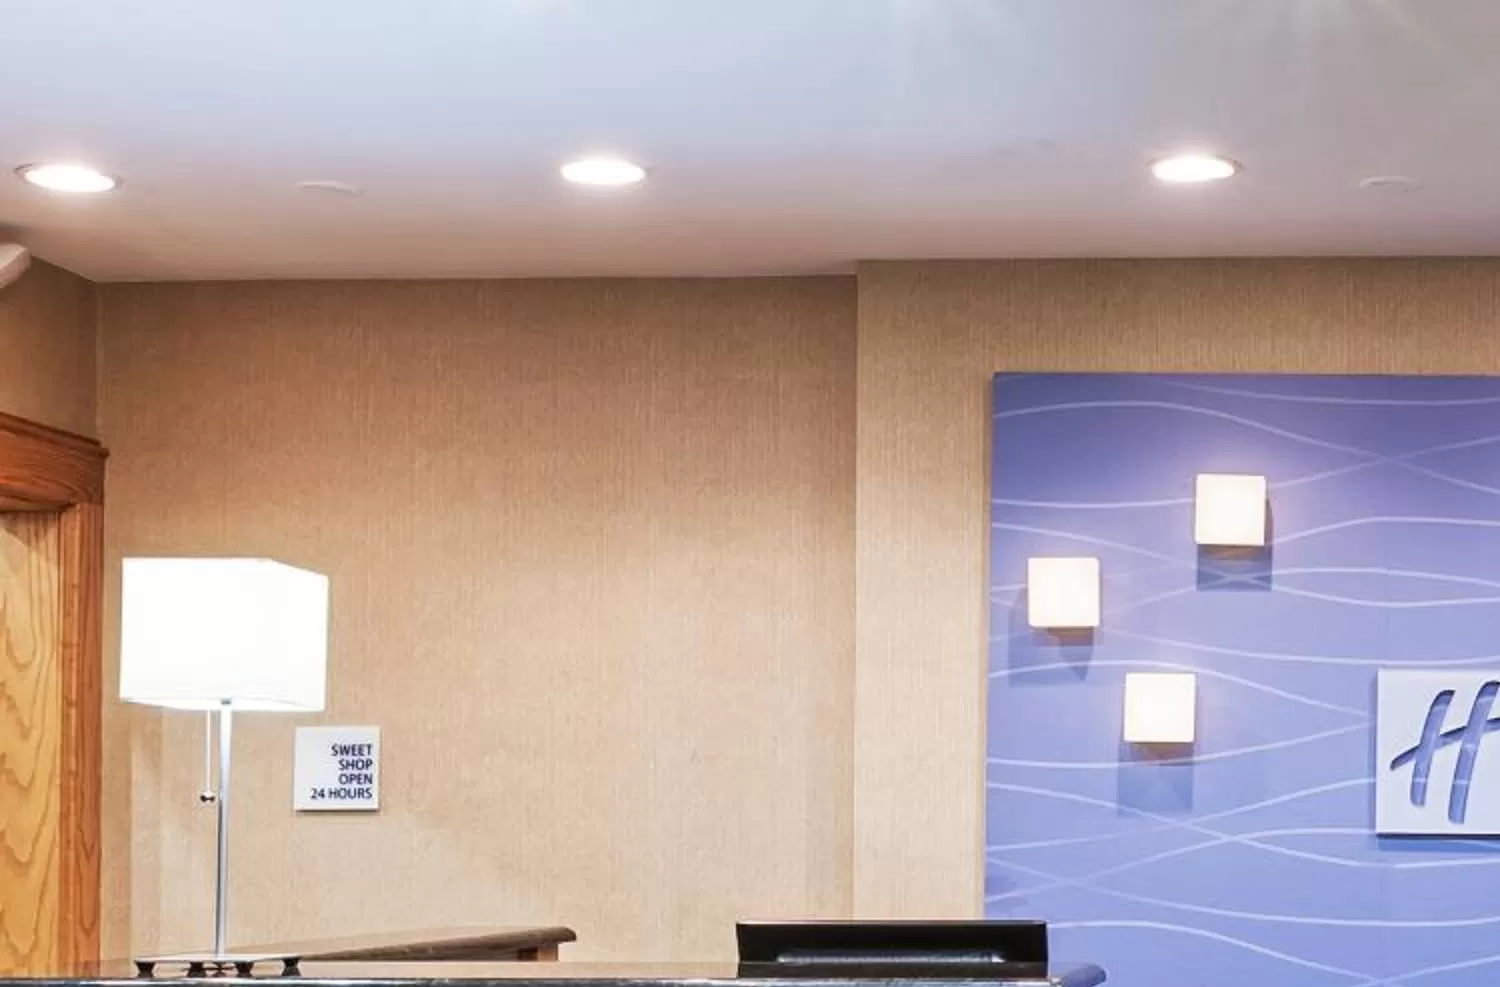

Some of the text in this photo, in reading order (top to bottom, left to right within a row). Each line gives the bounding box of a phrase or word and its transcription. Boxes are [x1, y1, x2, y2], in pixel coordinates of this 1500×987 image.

[331, 743, 373, 757] SWEET
[338, 758, 374, 771] SHOP
[338, 773, 374, 786] OPEN
[310, 787, 374, 800] 24 HOURS
